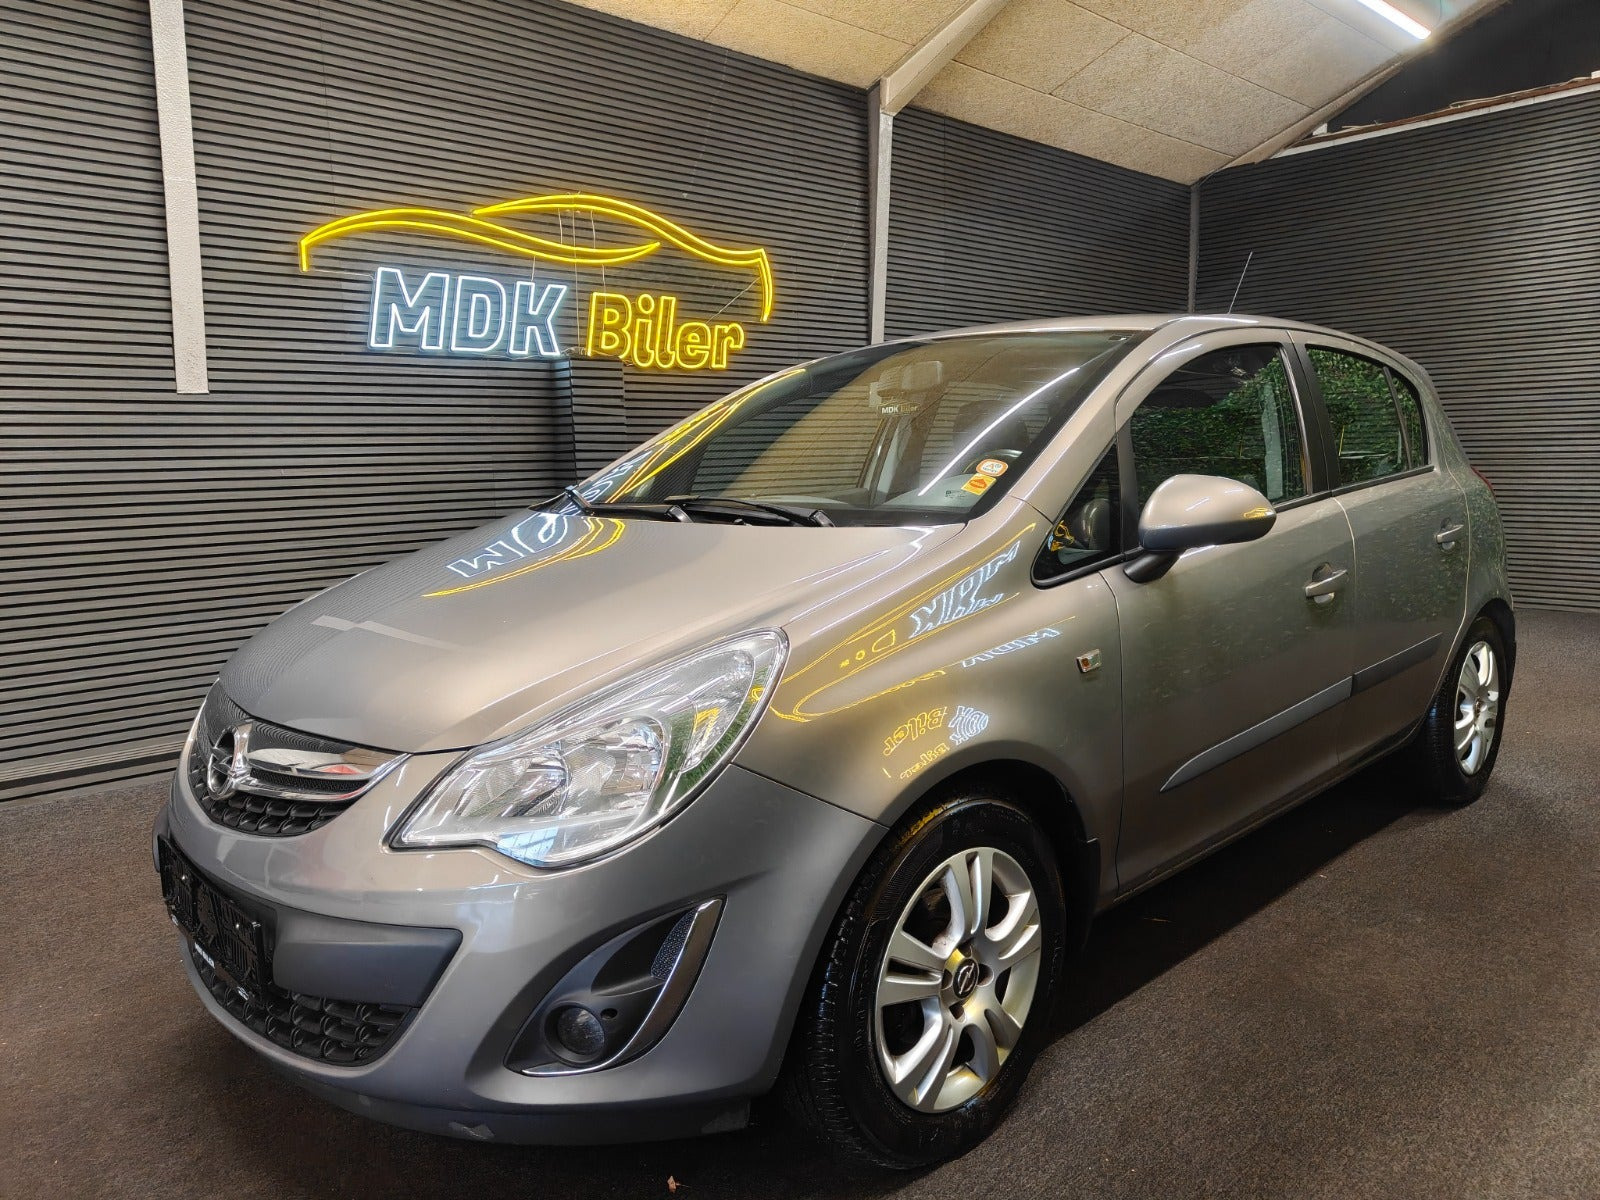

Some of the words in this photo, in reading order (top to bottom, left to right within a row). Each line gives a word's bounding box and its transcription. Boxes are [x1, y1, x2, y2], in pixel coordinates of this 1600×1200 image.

[368, 266, 568, 356] MDK
[586, 291, 745, 370] Biler
[881, 405, 899, 414] MDK
